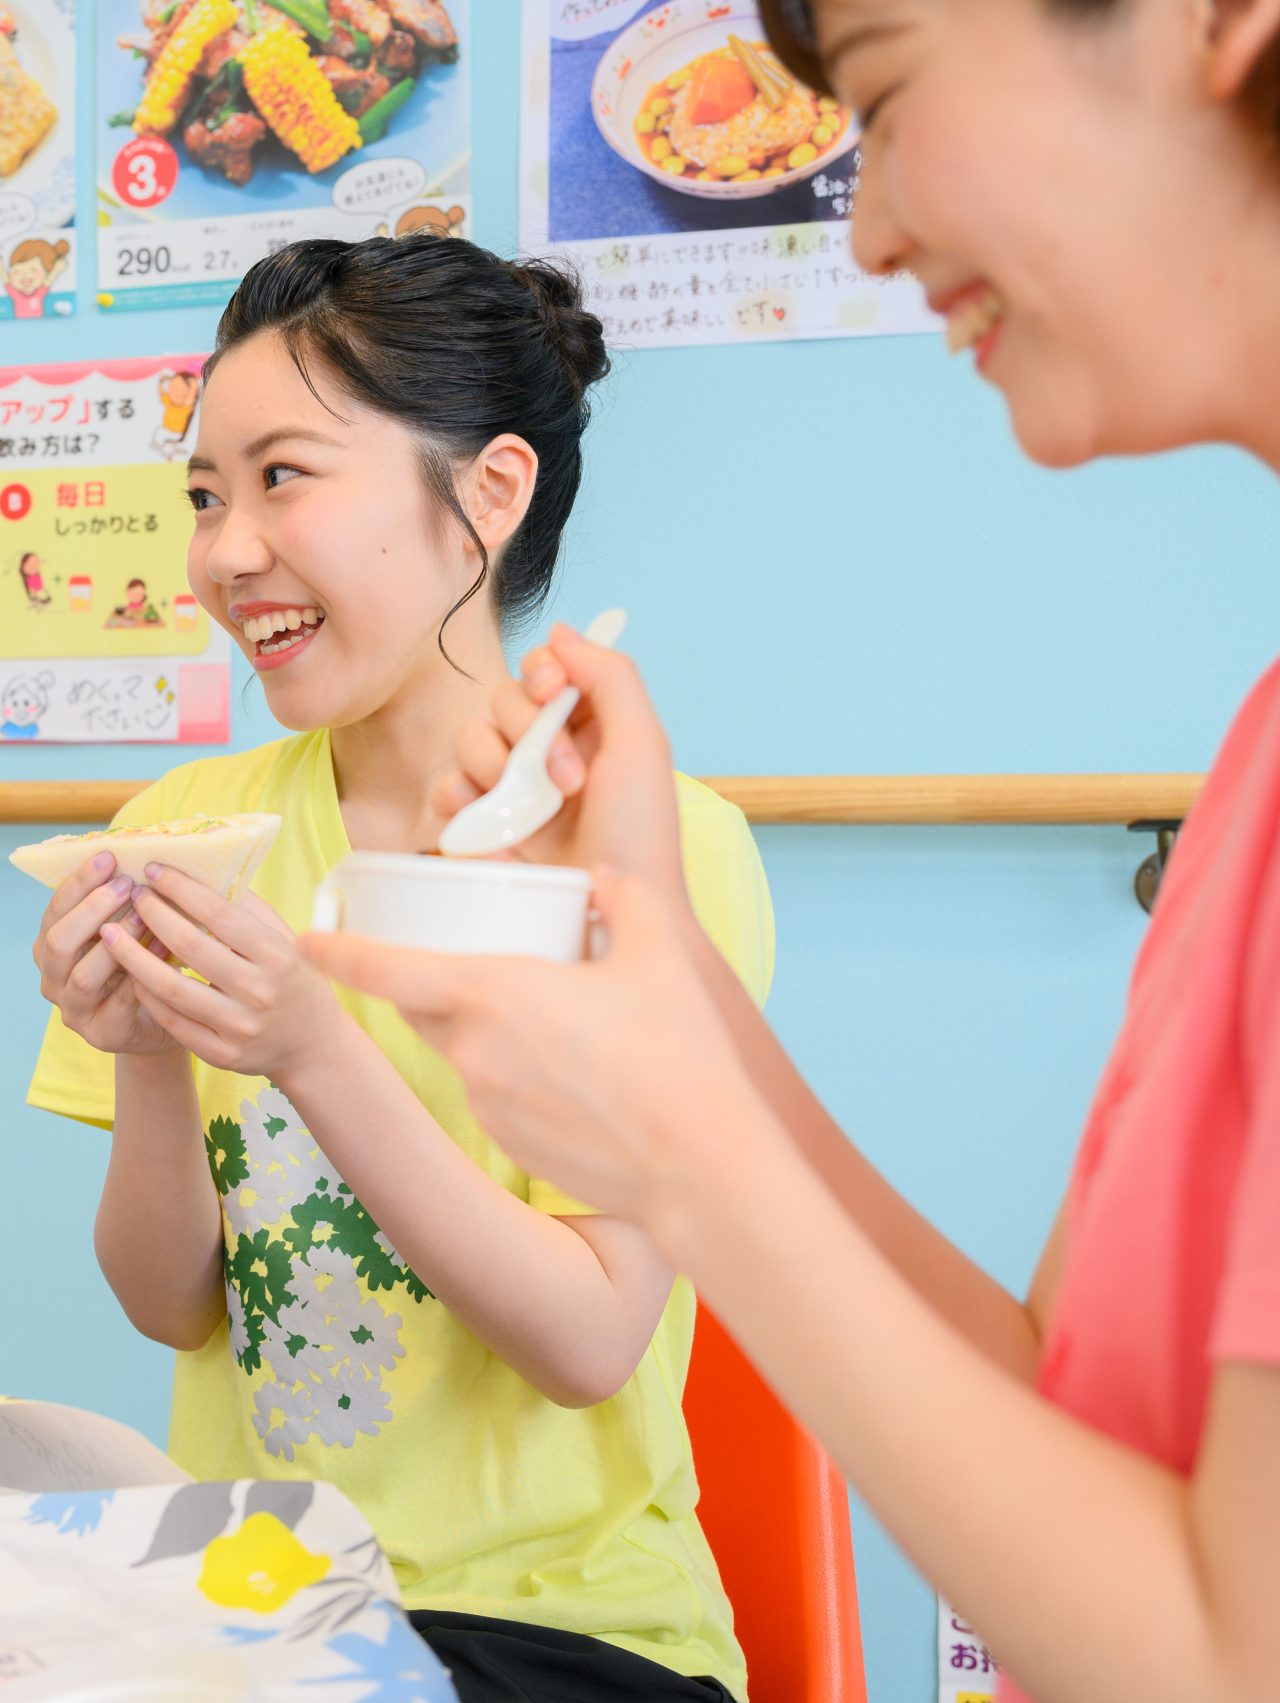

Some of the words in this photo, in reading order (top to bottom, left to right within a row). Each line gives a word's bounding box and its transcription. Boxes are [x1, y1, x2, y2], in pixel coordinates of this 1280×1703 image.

[117, 245, 171, 276] 290
[55, 481, 107, 508] 毎日
[54, 513, 159, 536] しっかりとる
